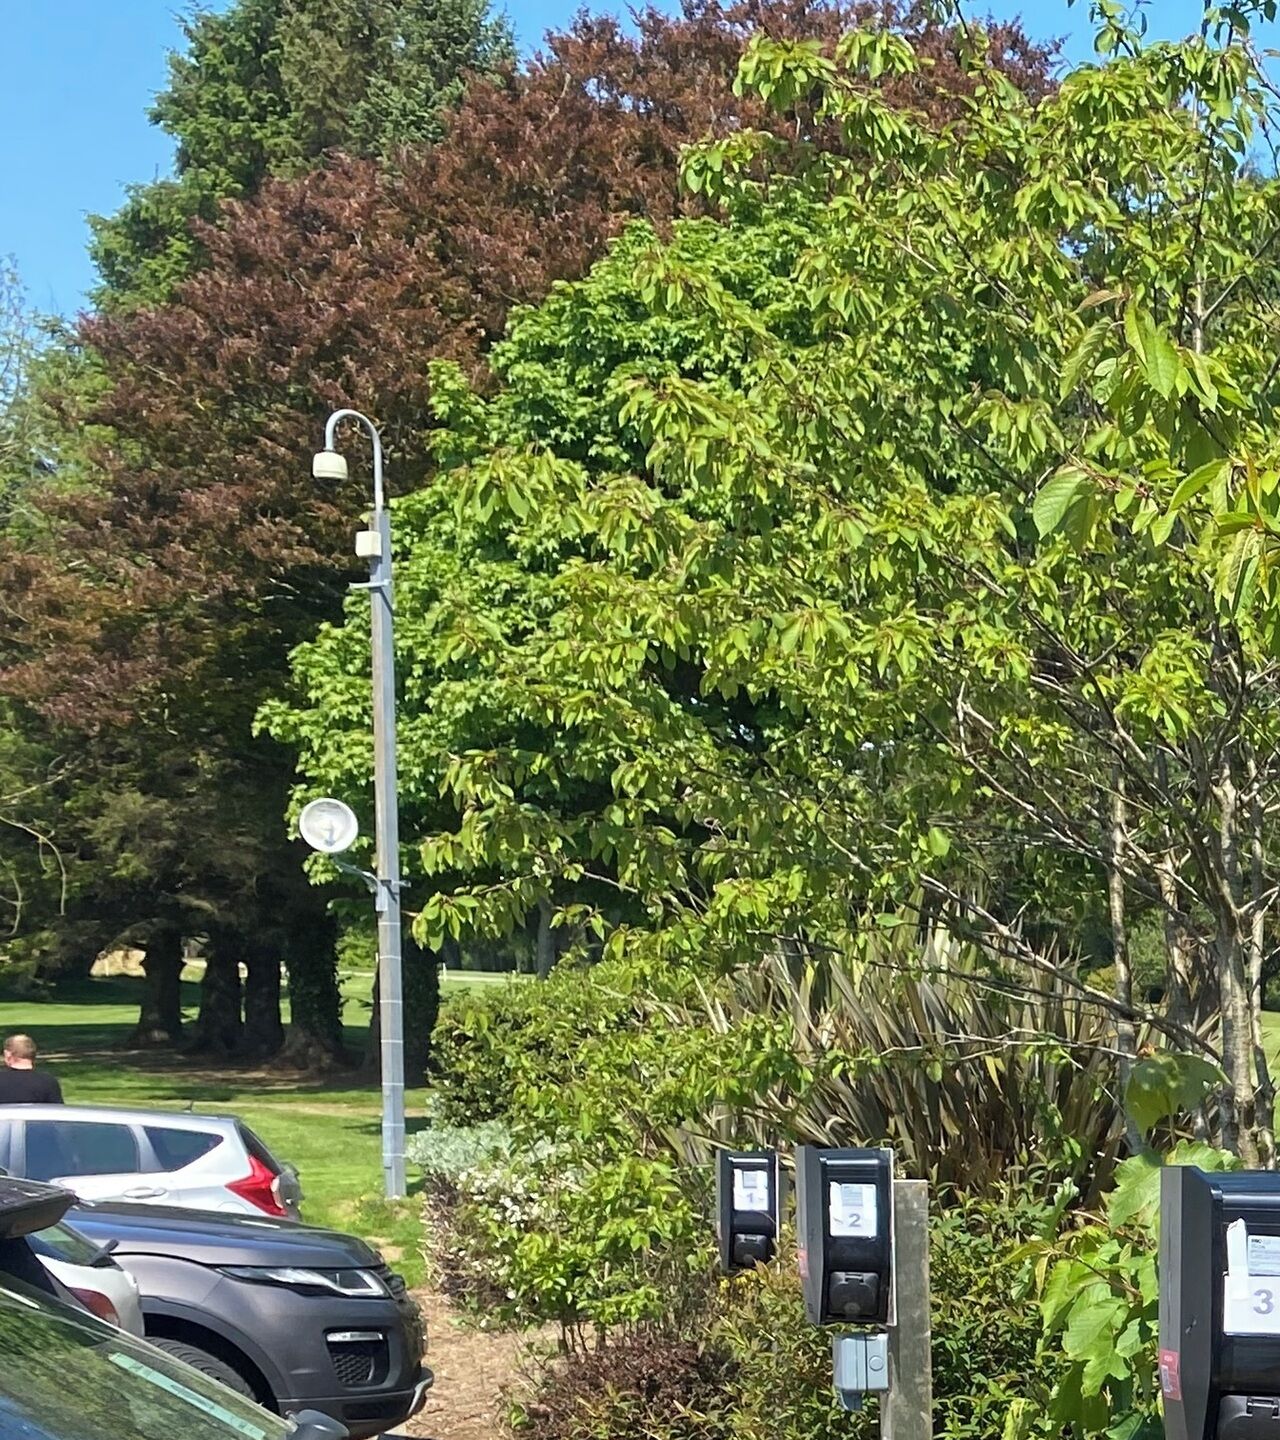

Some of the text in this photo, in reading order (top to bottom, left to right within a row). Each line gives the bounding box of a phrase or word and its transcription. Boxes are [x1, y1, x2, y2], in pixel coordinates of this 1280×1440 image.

[748, 1193, 755, 1204] 1
[848, 1213, 862, 1227] 2
[1253, 1289, 1275, 1315] 3
